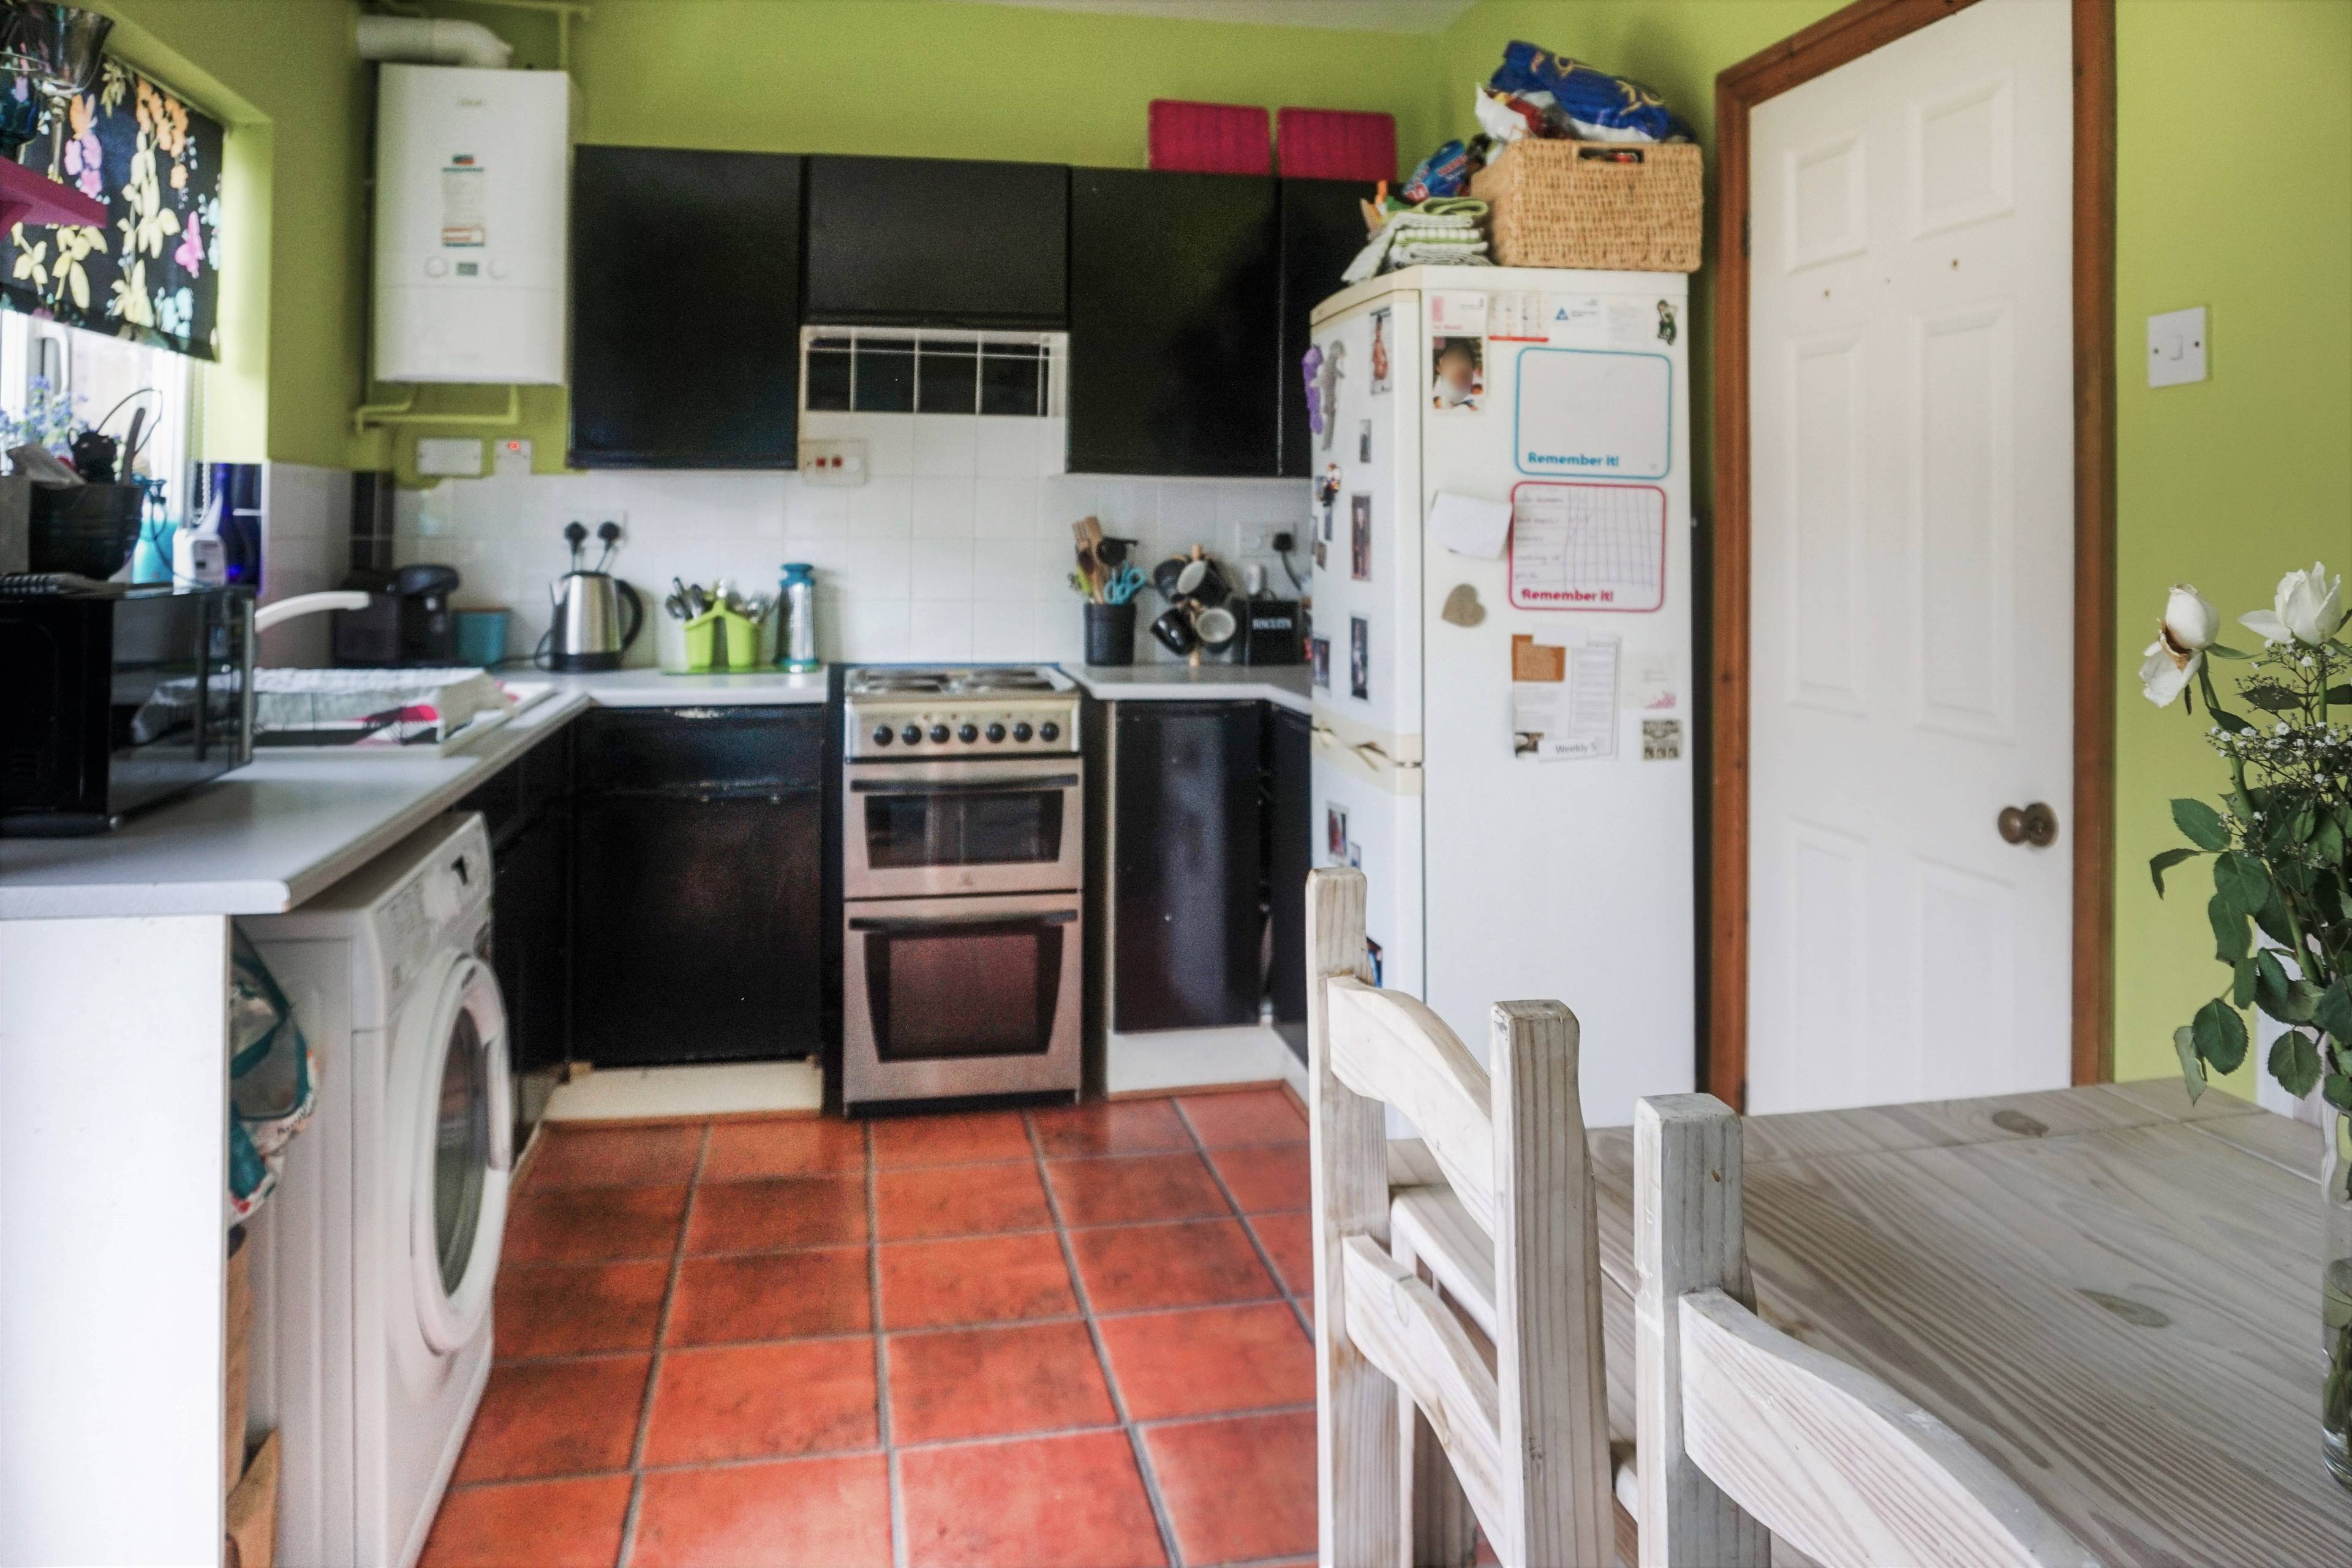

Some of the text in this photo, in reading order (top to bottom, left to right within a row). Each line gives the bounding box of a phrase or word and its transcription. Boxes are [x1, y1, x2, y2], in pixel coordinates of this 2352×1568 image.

[1528, 451, 1603, 466] Remember
[1522, 588, 1597, 601] Remember
[1555, 744, 1588, 755] Weekly
